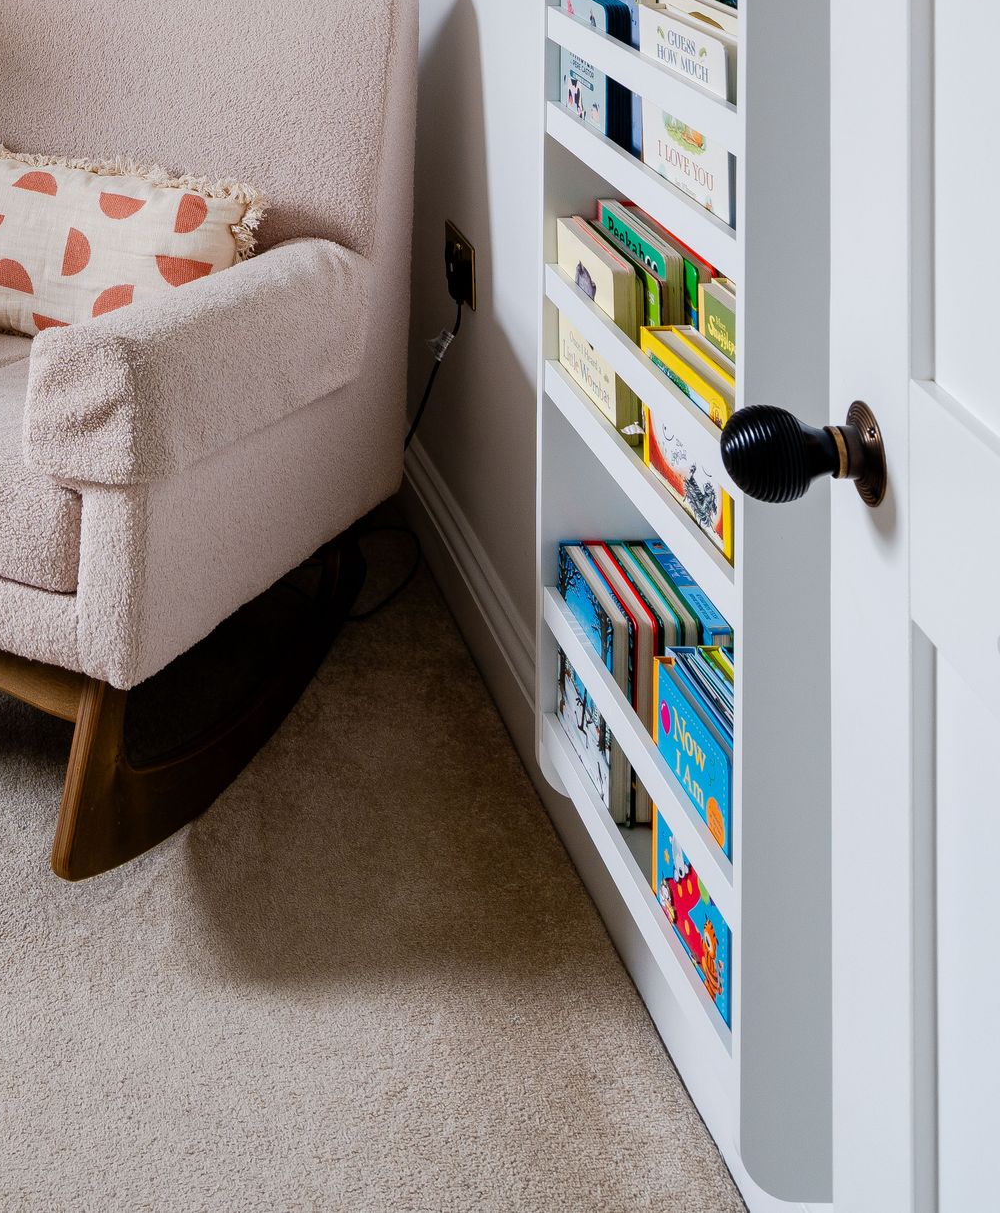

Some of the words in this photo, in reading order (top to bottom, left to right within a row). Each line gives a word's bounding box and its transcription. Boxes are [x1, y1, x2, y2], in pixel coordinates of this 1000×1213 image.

[657, 43, 678, 66] HOW
[680, 55, 709, 84] MUCH
[667, 29, 696, 56] GUESS
[657, 140, 662, 157] I
[665, 149, 691, 176] LOVE
[692, 161, 714, 191] YOU
[563, 339, 579, 373] Little
[580, 359, 611, 409] Wombat
[672, 706, 707, 771] Now
[675, 749, 681, 777] I
[683, 764, 705, 809] Am
